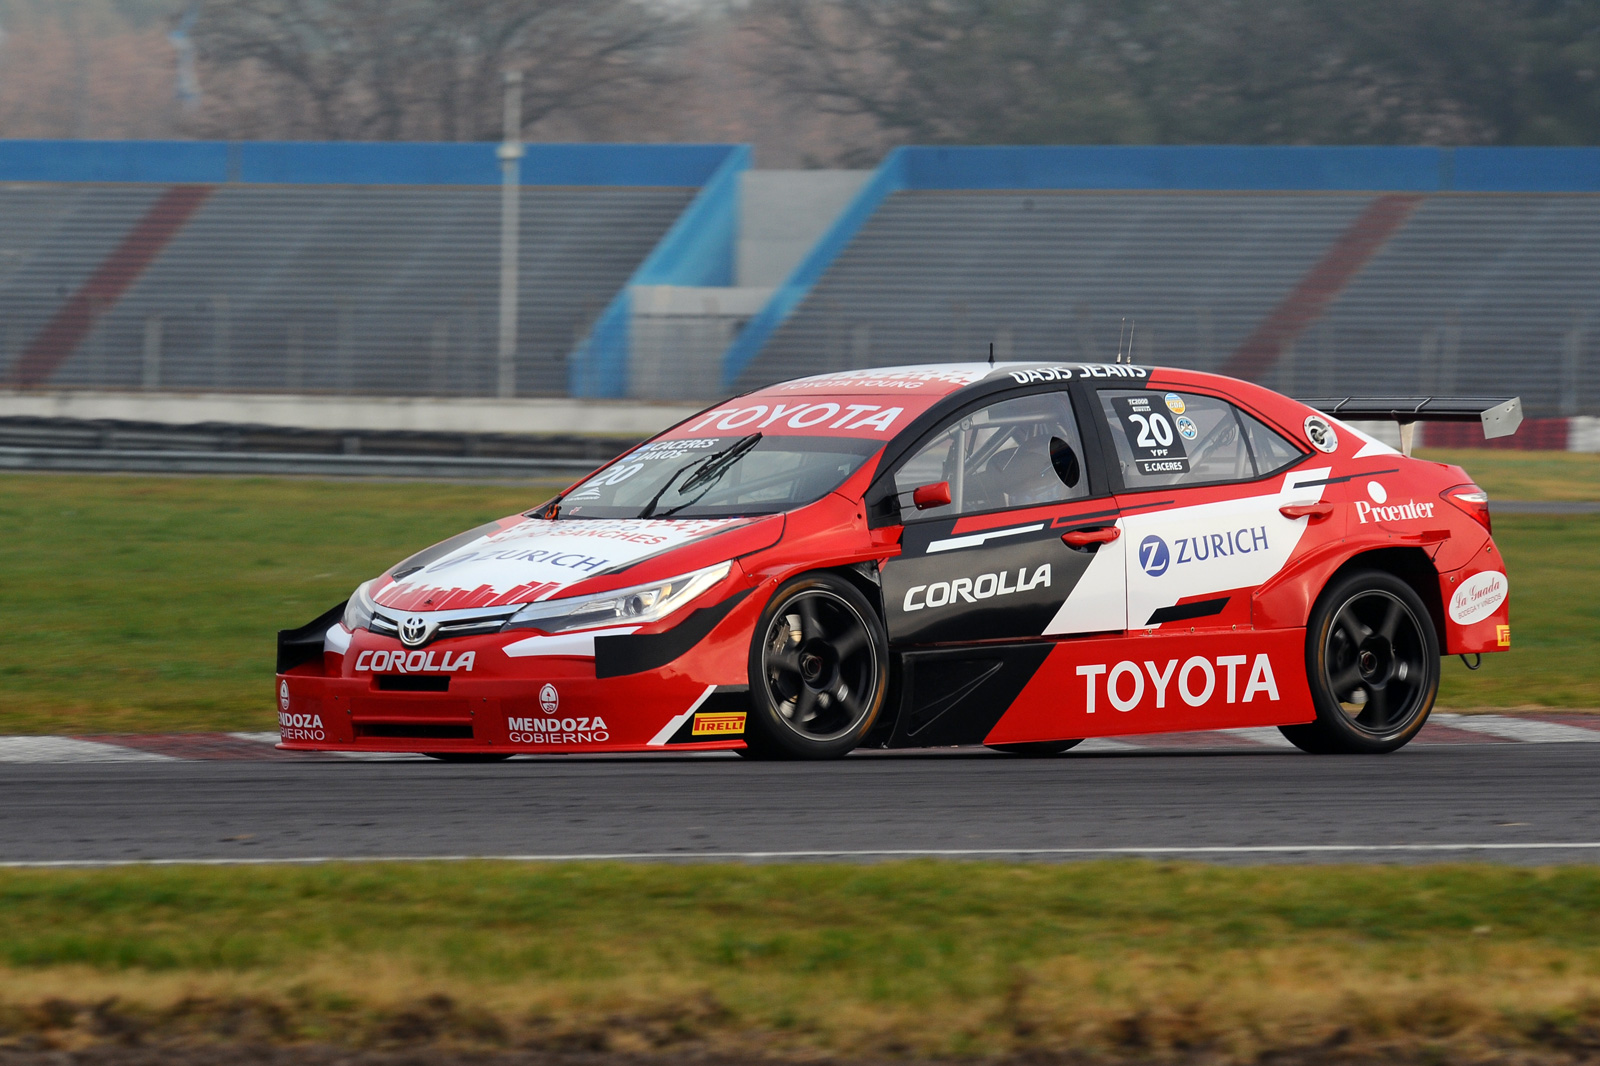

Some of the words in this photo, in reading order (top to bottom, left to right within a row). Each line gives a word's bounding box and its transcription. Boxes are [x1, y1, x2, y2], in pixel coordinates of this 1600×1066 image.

[855, 380, 924, 389] YOUNG
[687, 402, 905, 432] TOYOTA
[1128, 413, 1174, 448] 20
[650, 438, 719, 451] CACERES
[1150, 449, 1168, 457] YPF
[583, 462, 645, 489] 20
[1144, 462, 1183, 472] E.CACERES
[1174, 526, 1270, 565] ZURICH
[471, 548, 611, 572] ZURICH
[902, 563, 1052, 612] COROLLA
[1456, 591, 1467, 609] La
[355, 650, 477, 673] COROLLA
[1075, 653, 1281, 714] TOYOTA
[278, 711, 324, 729] NDOZA
[507, 716, 608, 733] MENDOZA
[693, 715, 746, 732] PIRELLI
[508, 732, 610, 744] GOBIERNO
